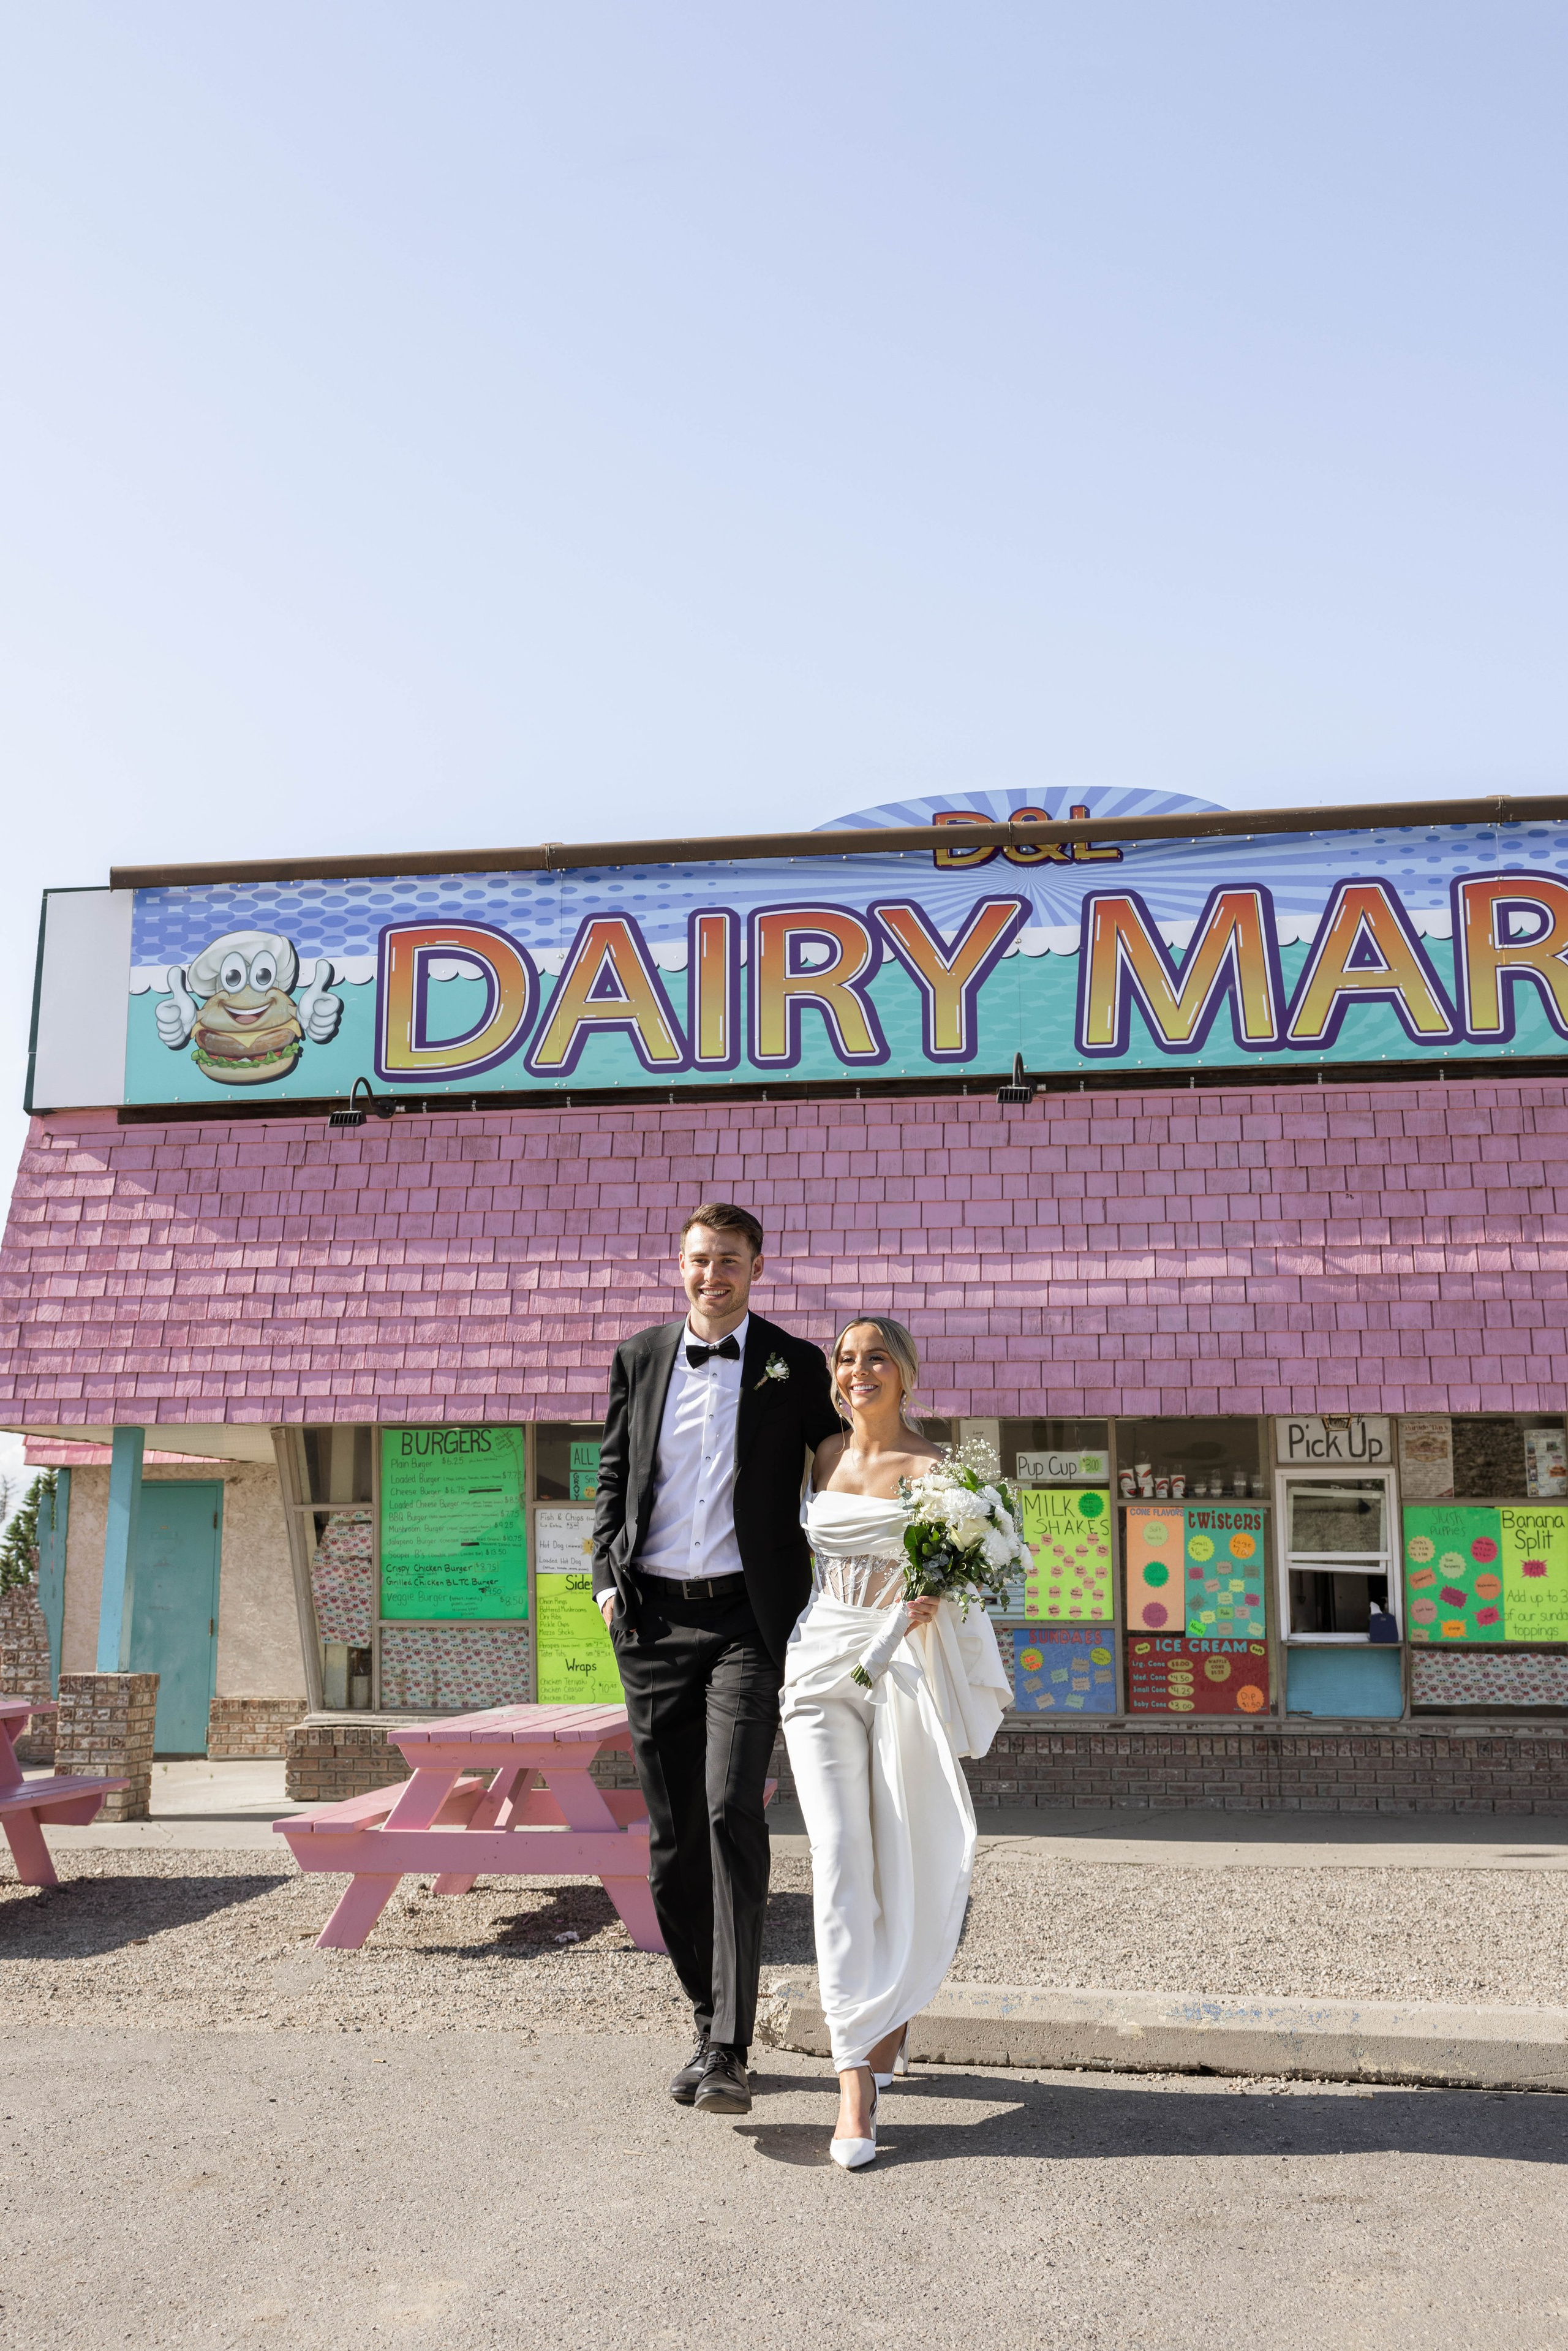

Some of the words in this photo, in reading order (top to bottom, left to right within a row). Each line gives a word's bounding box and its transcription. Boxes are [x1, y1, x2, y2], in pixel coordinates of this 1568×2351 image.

[932, 804, 1123, 870] D&L
[374, 894, 1036, 1083] DAIRY
[1074, 869, 1568, 1055] MAR
[401, 1429, 491, 1455] BURGERS
[1289, 1424, 1342, 1458] Pick
[1349, 1422, 1383, 1462] Up
[574, 1447, 594, 1465] ALL
[391, 1458, 409, 1469] Plain
[412, 1457, 432, 1472] Burger
[442, 1457, 464, 1465] $6.25
[1019, 1456, 1043, 1479] Pup
[1049, 1456, 1077, 1479] Cup
[391, 1473, 416, 1484] Loaded
[419, 1473, 440, 1487] Burger
[390, 1487, 417, 1496] Cheese
[420, 1487, 441, 1498] Burger
[389, 1499, 413, 1509] Loaded
[415, 1499, 437, 1508] Cheese
[439, 1498, 459, 1511] Burger
[504, 1496, 521, 1504] $8.5
[1024, 1493, 1075, 1517] MILK
[388, 1512, 403, 1522] BBQ
[407, 1512, 427, 1523] Burger
[565, 1512, 584, 1523] Chips
[1153, 1508, 1184, 1517] FLAVORS
[1431, 1508, 1463, 1525] Slush
[1502, 1510, 1566, 1528] Banana
[388, 1525, 421, 1533] Mushroom
[424, 1525, 445, 1536] Burger
[1033, 1518, 1109, 1536] SHAKES
[417, 1536, 436, 1545] Burger
[539, 1540, 549, 1549] Hot
[553, 1540, 564, 1550] Dog
[1233, 1536, 1251, 1549] Large
[1515, 1529, 1554, 1557] Split
[388, 1550, 410, 1560] Sooper
[571, 1557, 581, 1566] Dog
[386, 1564, 409, 1574] Crispy
[414, 1563, 443, 1572] Chicken
[445, 1564, 472, 1574] Burger
[386, 1576, 412, 1586] Grilled
[413, 1578, 443, 1587] Chicken
[472, 1578, 499, 1588] Burger
[386, 1593, 414, 1606] Veggie
[418, 1591, 447, 1607] Burger
[554, 1596, 568, 1606] Rings
[1507, 1589, 1526, 1602] Add
[1530, 1594, 1544, 1607] up
[1546, 1589, 1558, 1602] to
[1560, 1588, 1568, 1603] 3
[1504, 1608, 1516, 1621] of
[1518, 1613, 1536, 1621] our
[1028, 1628, 1102, 1645] SUNDAES
[1513, 1623, 1559, 1641] toppings
[1156, 1639, 1182, 1652] ICE
[1188, 1639, 1248, 1653] CREAM
[565, 1658, 597, 1677] Wraps
[564, 1677, 588, 1686] Teriyaki
[1240, 1692, 1256, 1701] Dip
[1133, 1700, 1149, 1708] Baby
